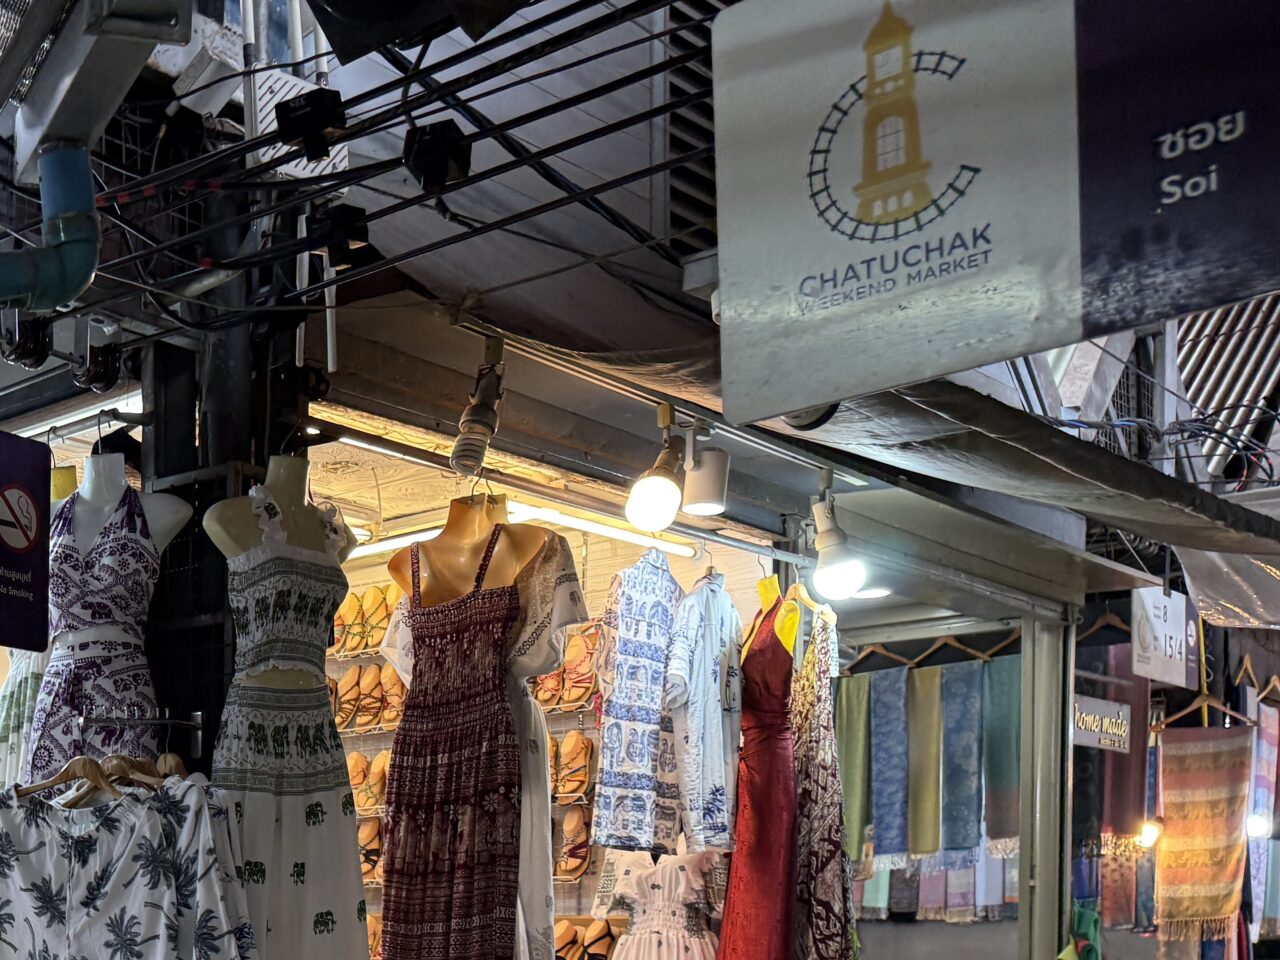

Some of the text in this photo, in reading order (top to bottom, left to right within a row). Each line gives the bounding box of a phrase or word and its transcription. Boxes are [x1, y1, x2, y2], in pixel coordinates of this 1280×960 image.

[1156, 110, 1246, 160] ซอย
[1158, 164, 1219, 205] Soi
[798, 222, 993, 299] CHATUCHAK
[797, 248, 993, 317] WEEKEND MARKET
[8, 586, 34, 602] Smoking
[1162, 605, 1168, 623] 8
[1164, 633, 1183, 662] 15/4
[1074, 703, 1128, 738] home made
